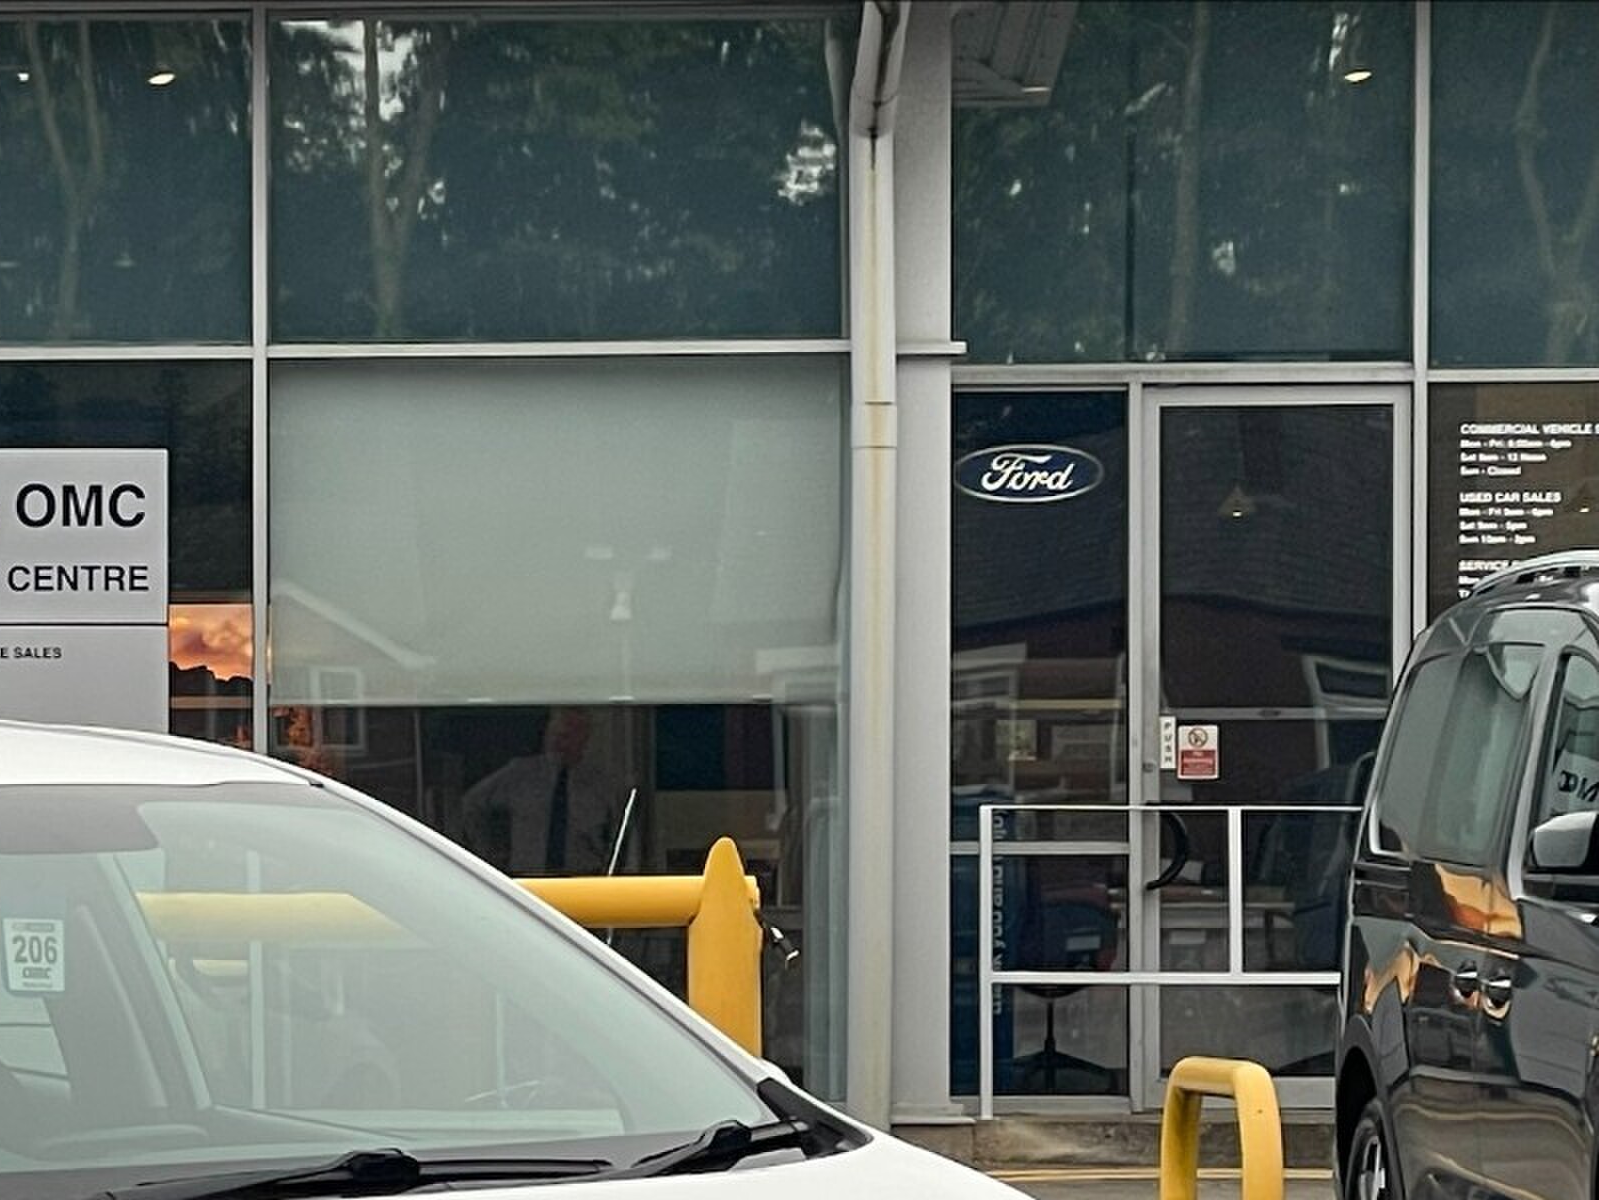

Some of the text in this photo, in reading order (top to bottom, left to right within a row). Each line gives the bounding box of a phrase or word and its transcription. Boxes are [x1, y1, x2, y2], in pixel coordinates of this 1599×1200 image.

[981, 452, 1076, 492] Ford
[16, 482, 147, 528] OMC
[1494, 491, 1521, 503] CAR
[1522, 491, 1562, 503] SALES
[7, 564, 150, 593] CENTRE
[13, 647, 63, 659] SALES
[11, 934, 59, 965] 206
